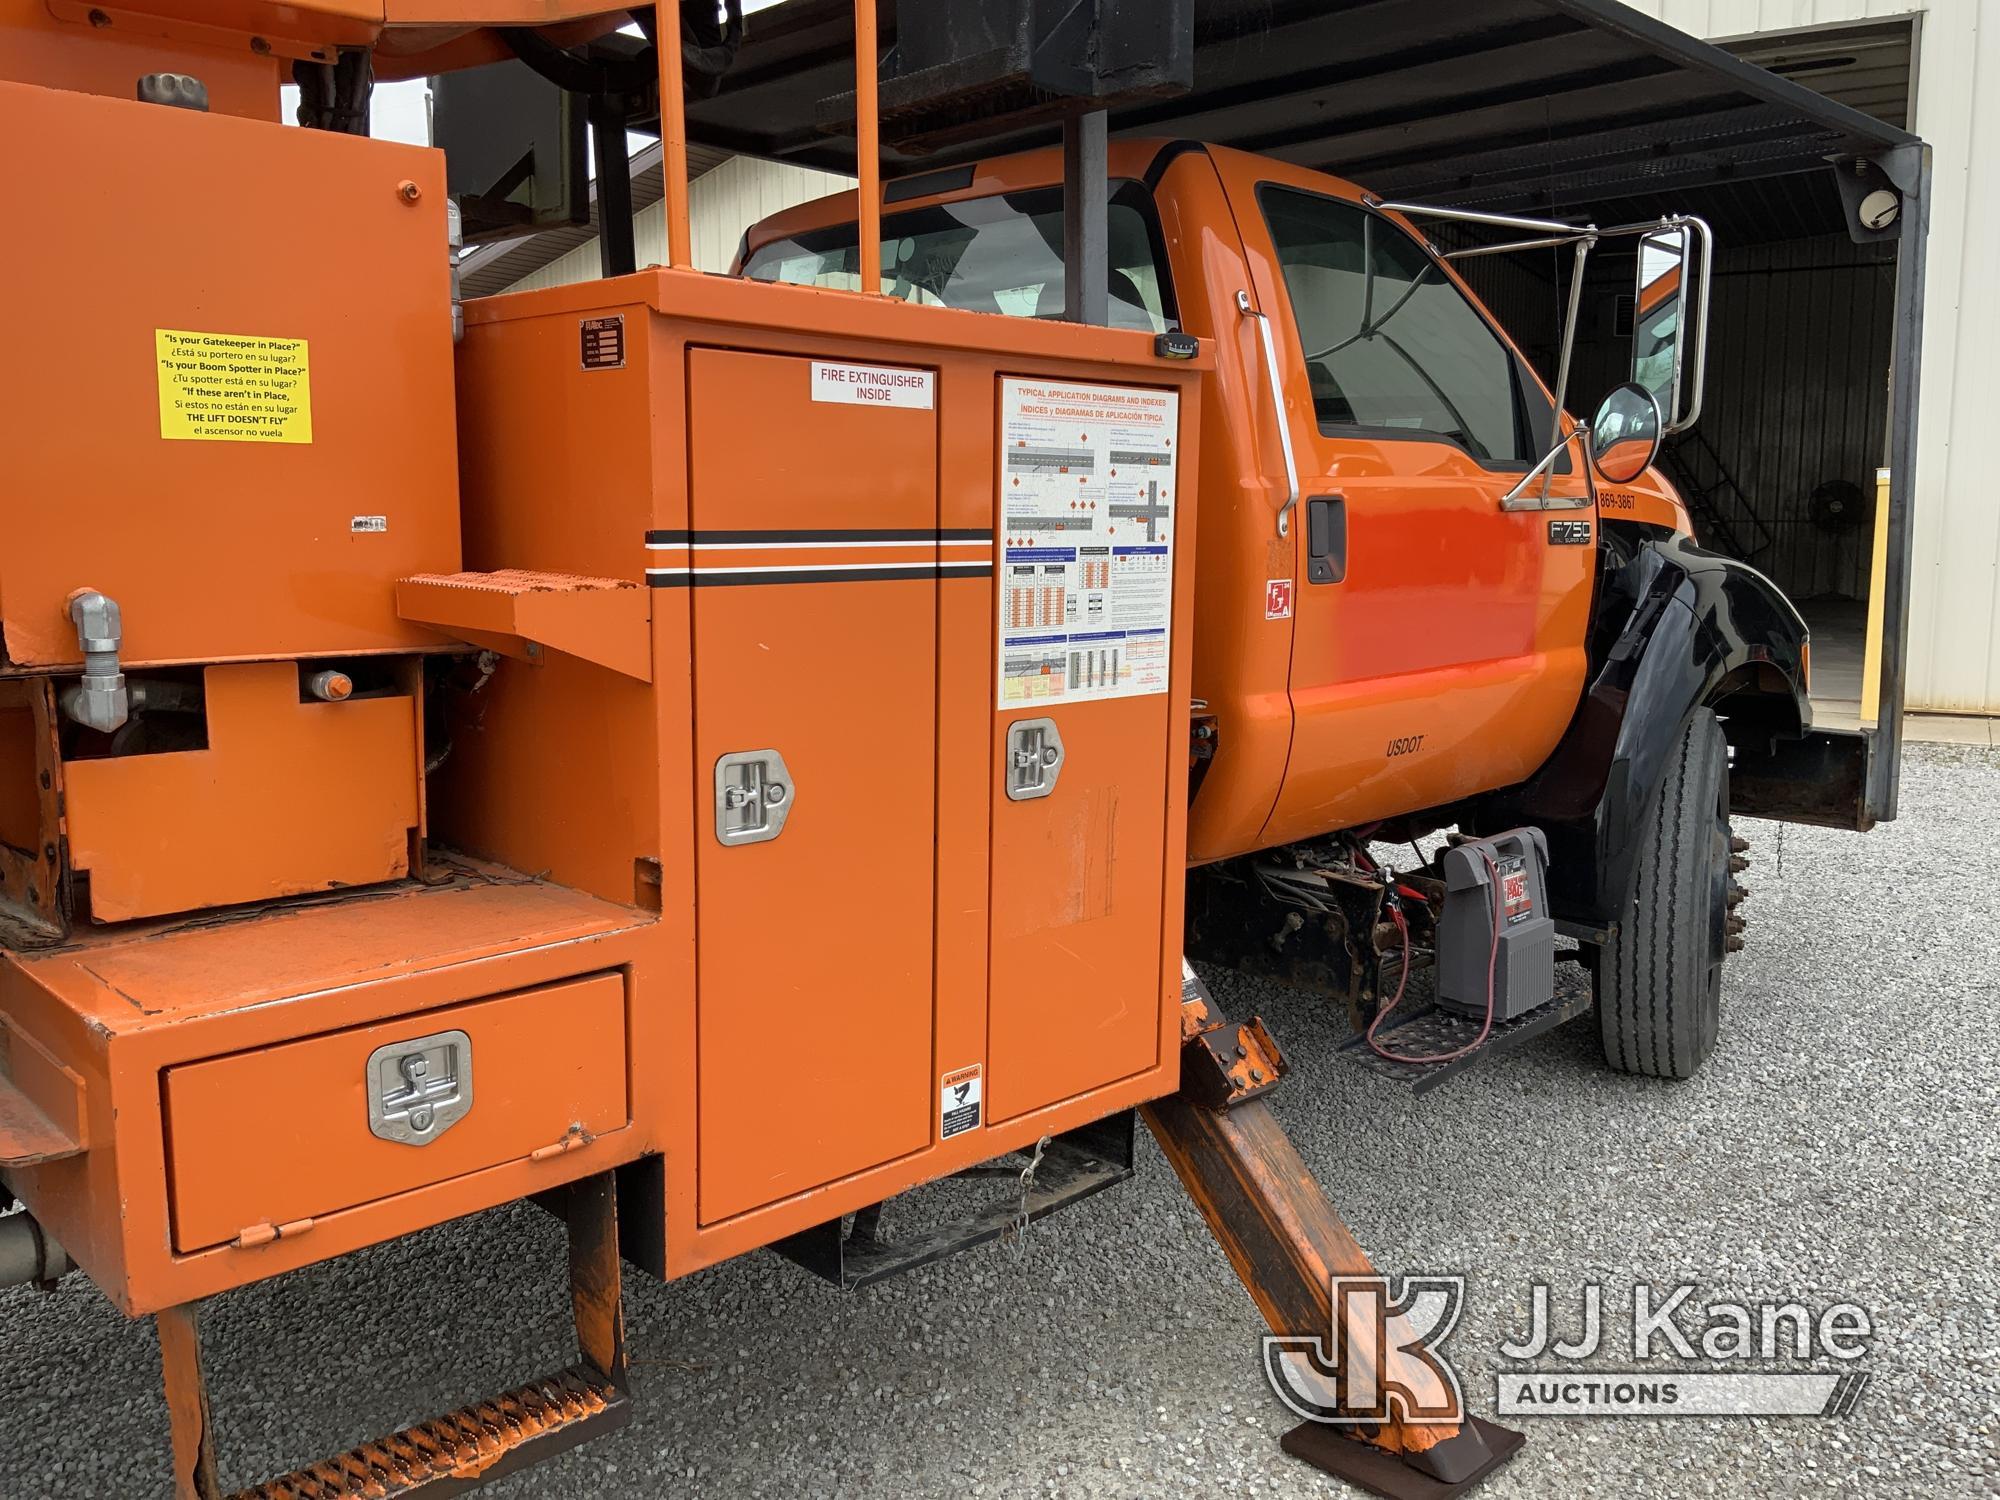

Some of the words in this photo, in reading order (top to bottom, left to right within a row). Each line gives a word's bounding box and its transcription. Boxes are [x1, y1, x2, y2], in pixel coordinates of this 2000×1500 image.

[179, 337, 201, 345] your
[203, 338, 256, 349] Gatekeeper
[269, 342, 300, 351] Place?”
[172, 348, 194, 356] ¿Está
[210, 351, 243, 359] portero
[270, 354, 296, 364] lugar?
[176, 362, 197, 370] your
[200, 362, 226, 371] Boom
[229, 364, 261, 373] Spotter
[264, 366, 272, 374] in
[274, 367, 306, 376] Place?”
[173, 374, 188, 382] ¿Tu
[190, 376, 223, 384] spotter
[225, 377, 243, 385] está
[271, 379, 297, 389] lugar?
[821, 368, 845, 382] FIRE
[849, 371, 924, 388] EXTINGUISHER
[196, 388, 222, 397] these
[224, 390, 251, 398] aren’t
[253, 391, 261, 399] in
[264, 391, 290, 402] Place,
[857, 387, 891, 401] INSIDE
[1018, 387, 1046, 397] TYPICAL
[1048, 390, 1091, 401] APPLICATION
[1092, 394, 1125, 403] DIAGRAMS
[1141, 398, 1166, 407] INDEXES
[175, 400, 183, 408] Si
[276, 404, 298, 414] lugar
[1055, 407, 1094, 418] DIAGRAMAS
[1106, 411, 1142, 420] APLICACIÓN
[187, 414, 205, 422] THE
[208, 414, 226, 422] LIFT
[228, 415, 267, 424] DOESN’T
[270, 417, 288, 425] FLY”
[194, 426, 202, 434] el
[259, 429, 283, 437] vuela
[1600, 493, 1635, 509] 869-3867
[1387, 734, 1424, 757] USDOT
[951, 1069, 978, 1082] WARNING
